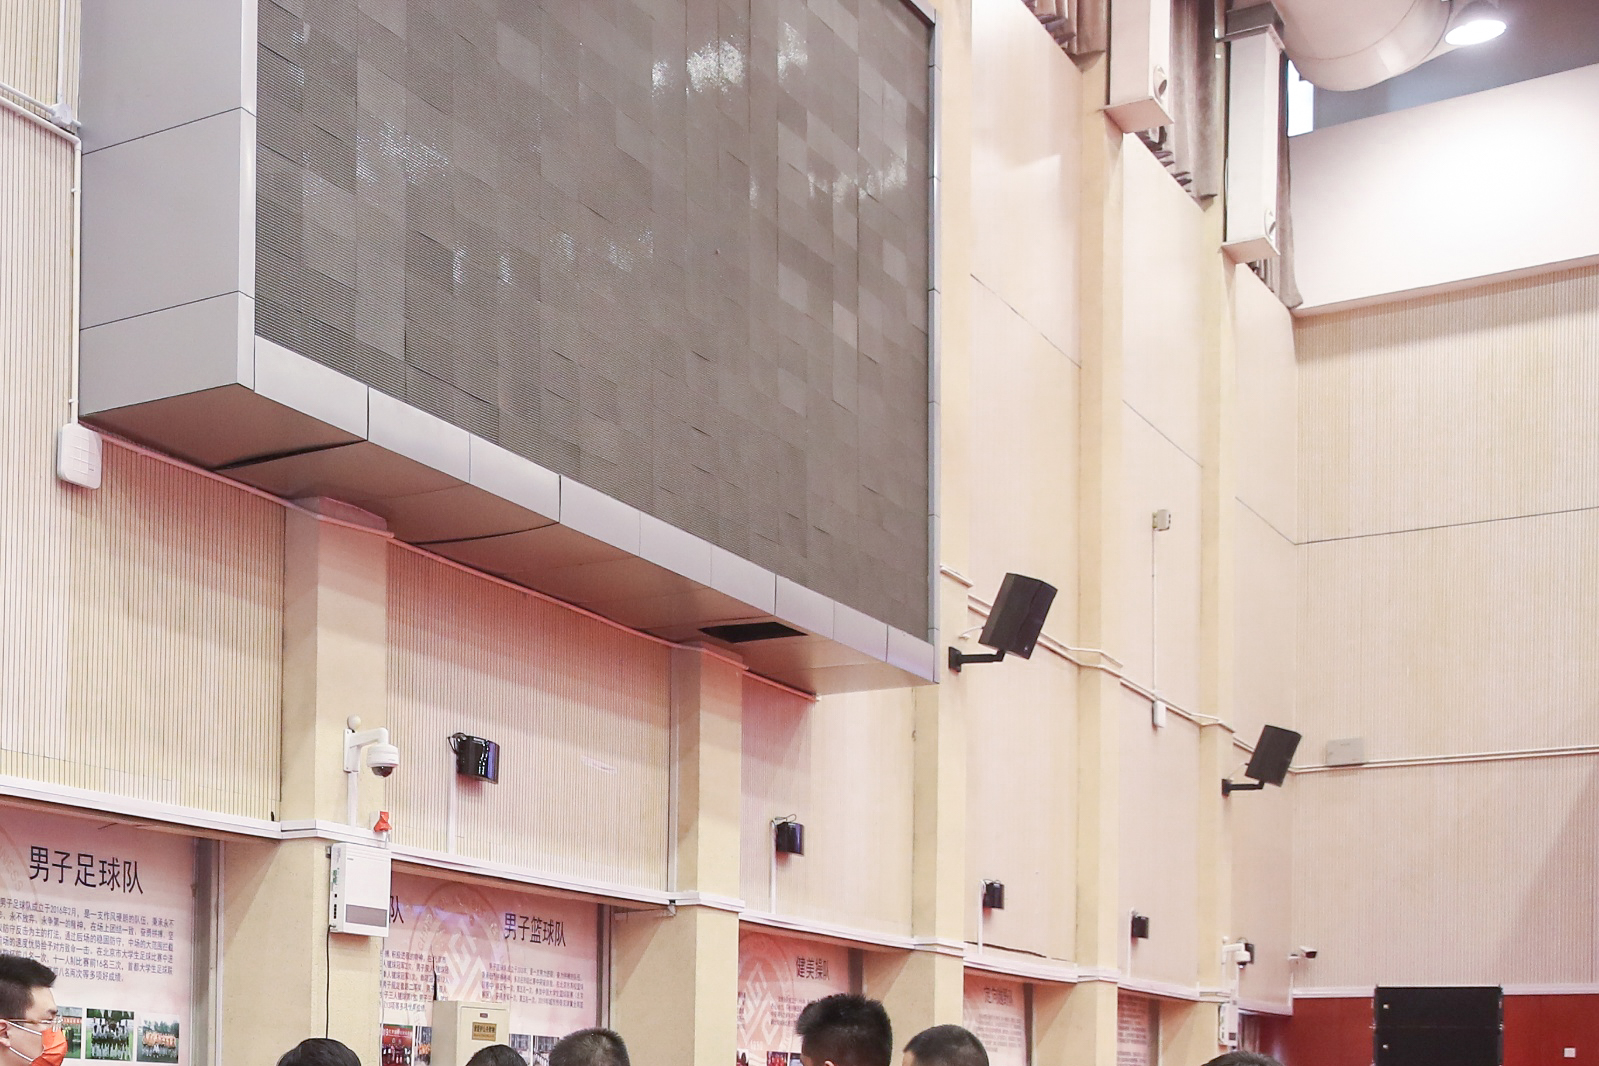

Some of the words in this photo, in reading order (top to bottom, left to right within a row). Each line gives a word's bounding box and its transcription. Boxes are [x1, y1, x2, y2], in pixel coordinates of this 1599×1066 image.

[29, 845, 144, 895] 男子足球队
[503, 912, 566, 947] 男子篮球队
